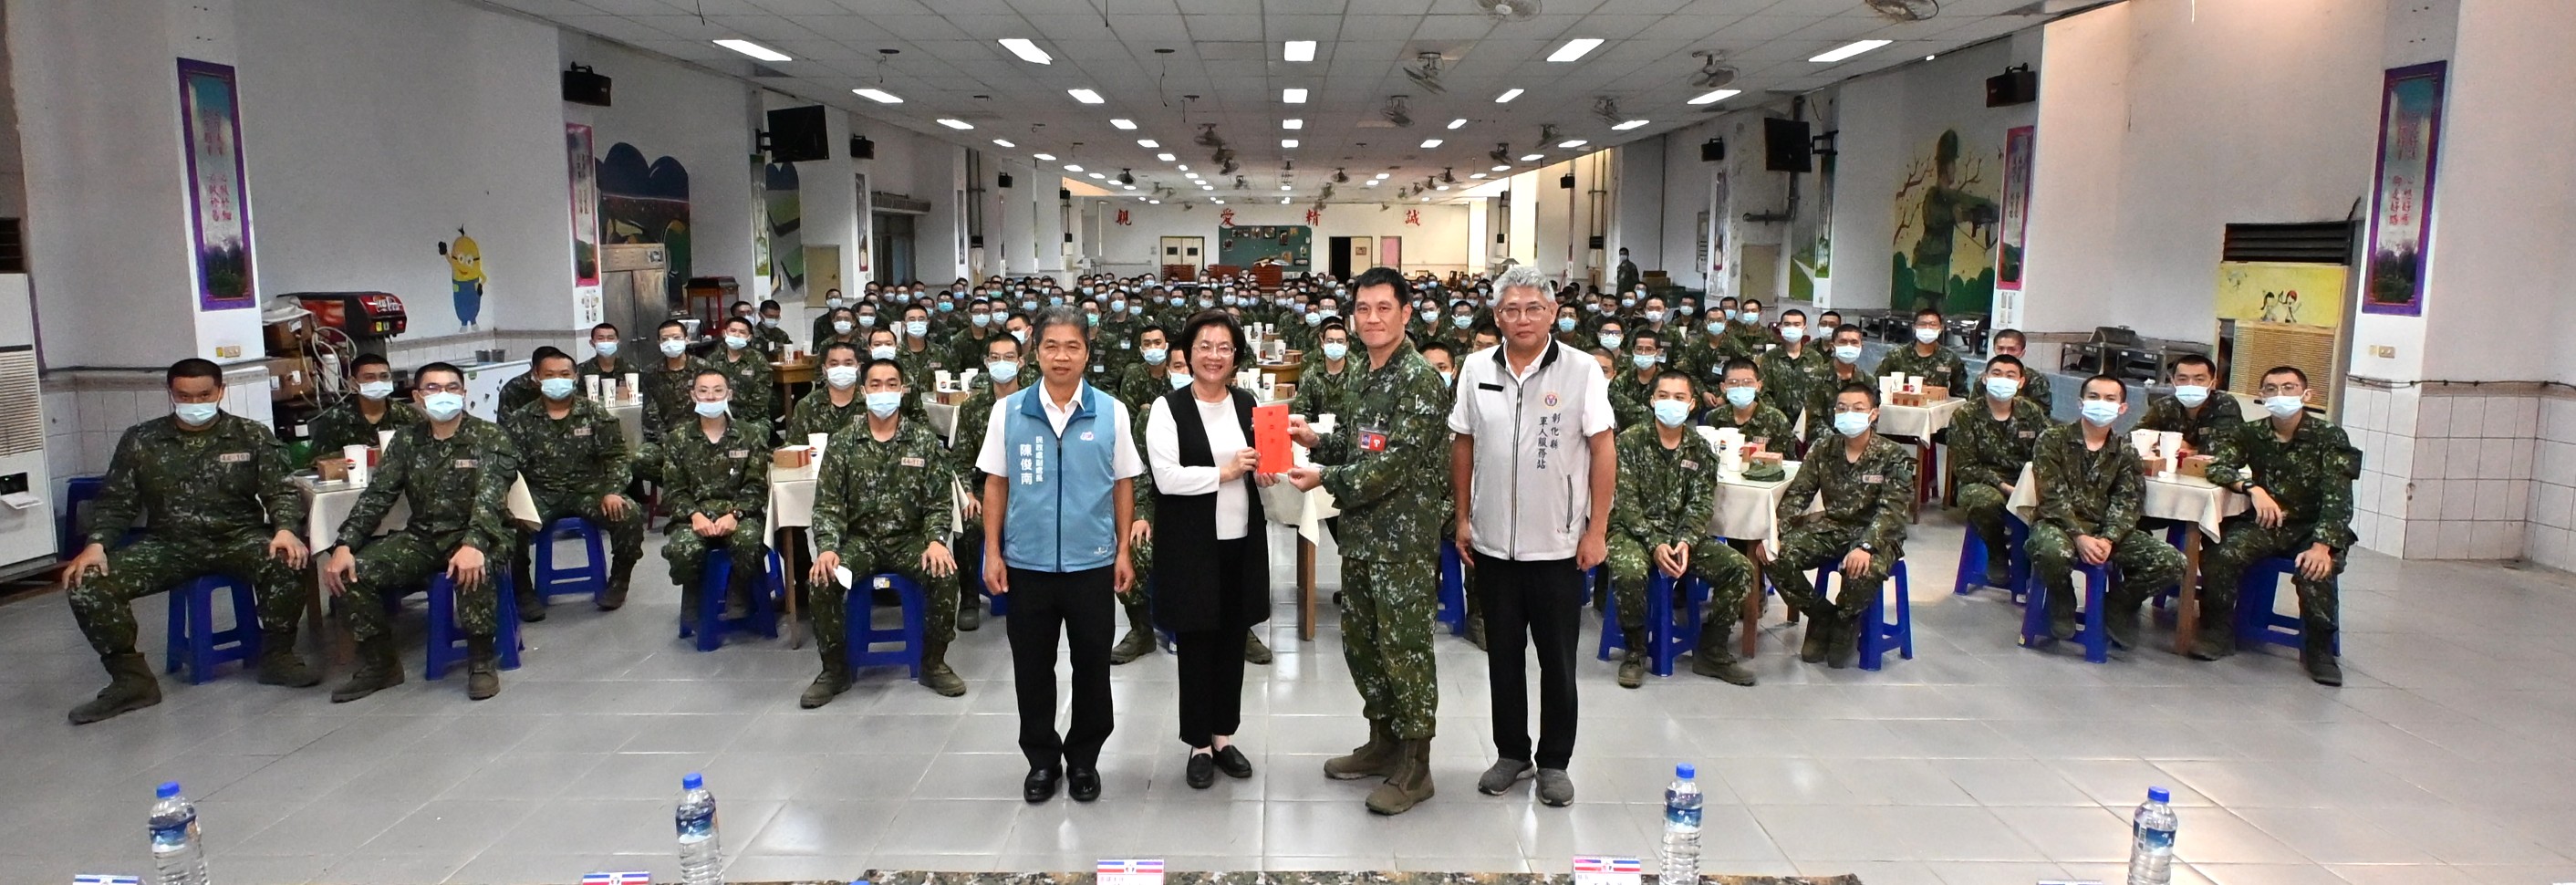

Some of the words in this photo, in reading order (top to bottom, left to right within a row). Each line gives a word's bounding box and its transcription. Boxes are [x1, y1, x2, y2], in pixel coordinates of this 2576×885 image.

[1220, 208, 1236, 226] 愛
[1305, 208, 1321, 226] 精
[1405, 209, 1420, 226] 誠
[1536, 416, 1548, 470] 軍人服務站
[1550, 412, 1561, 449] 彰化縣
[1019, 443, 1033, 485] 陳俊南
